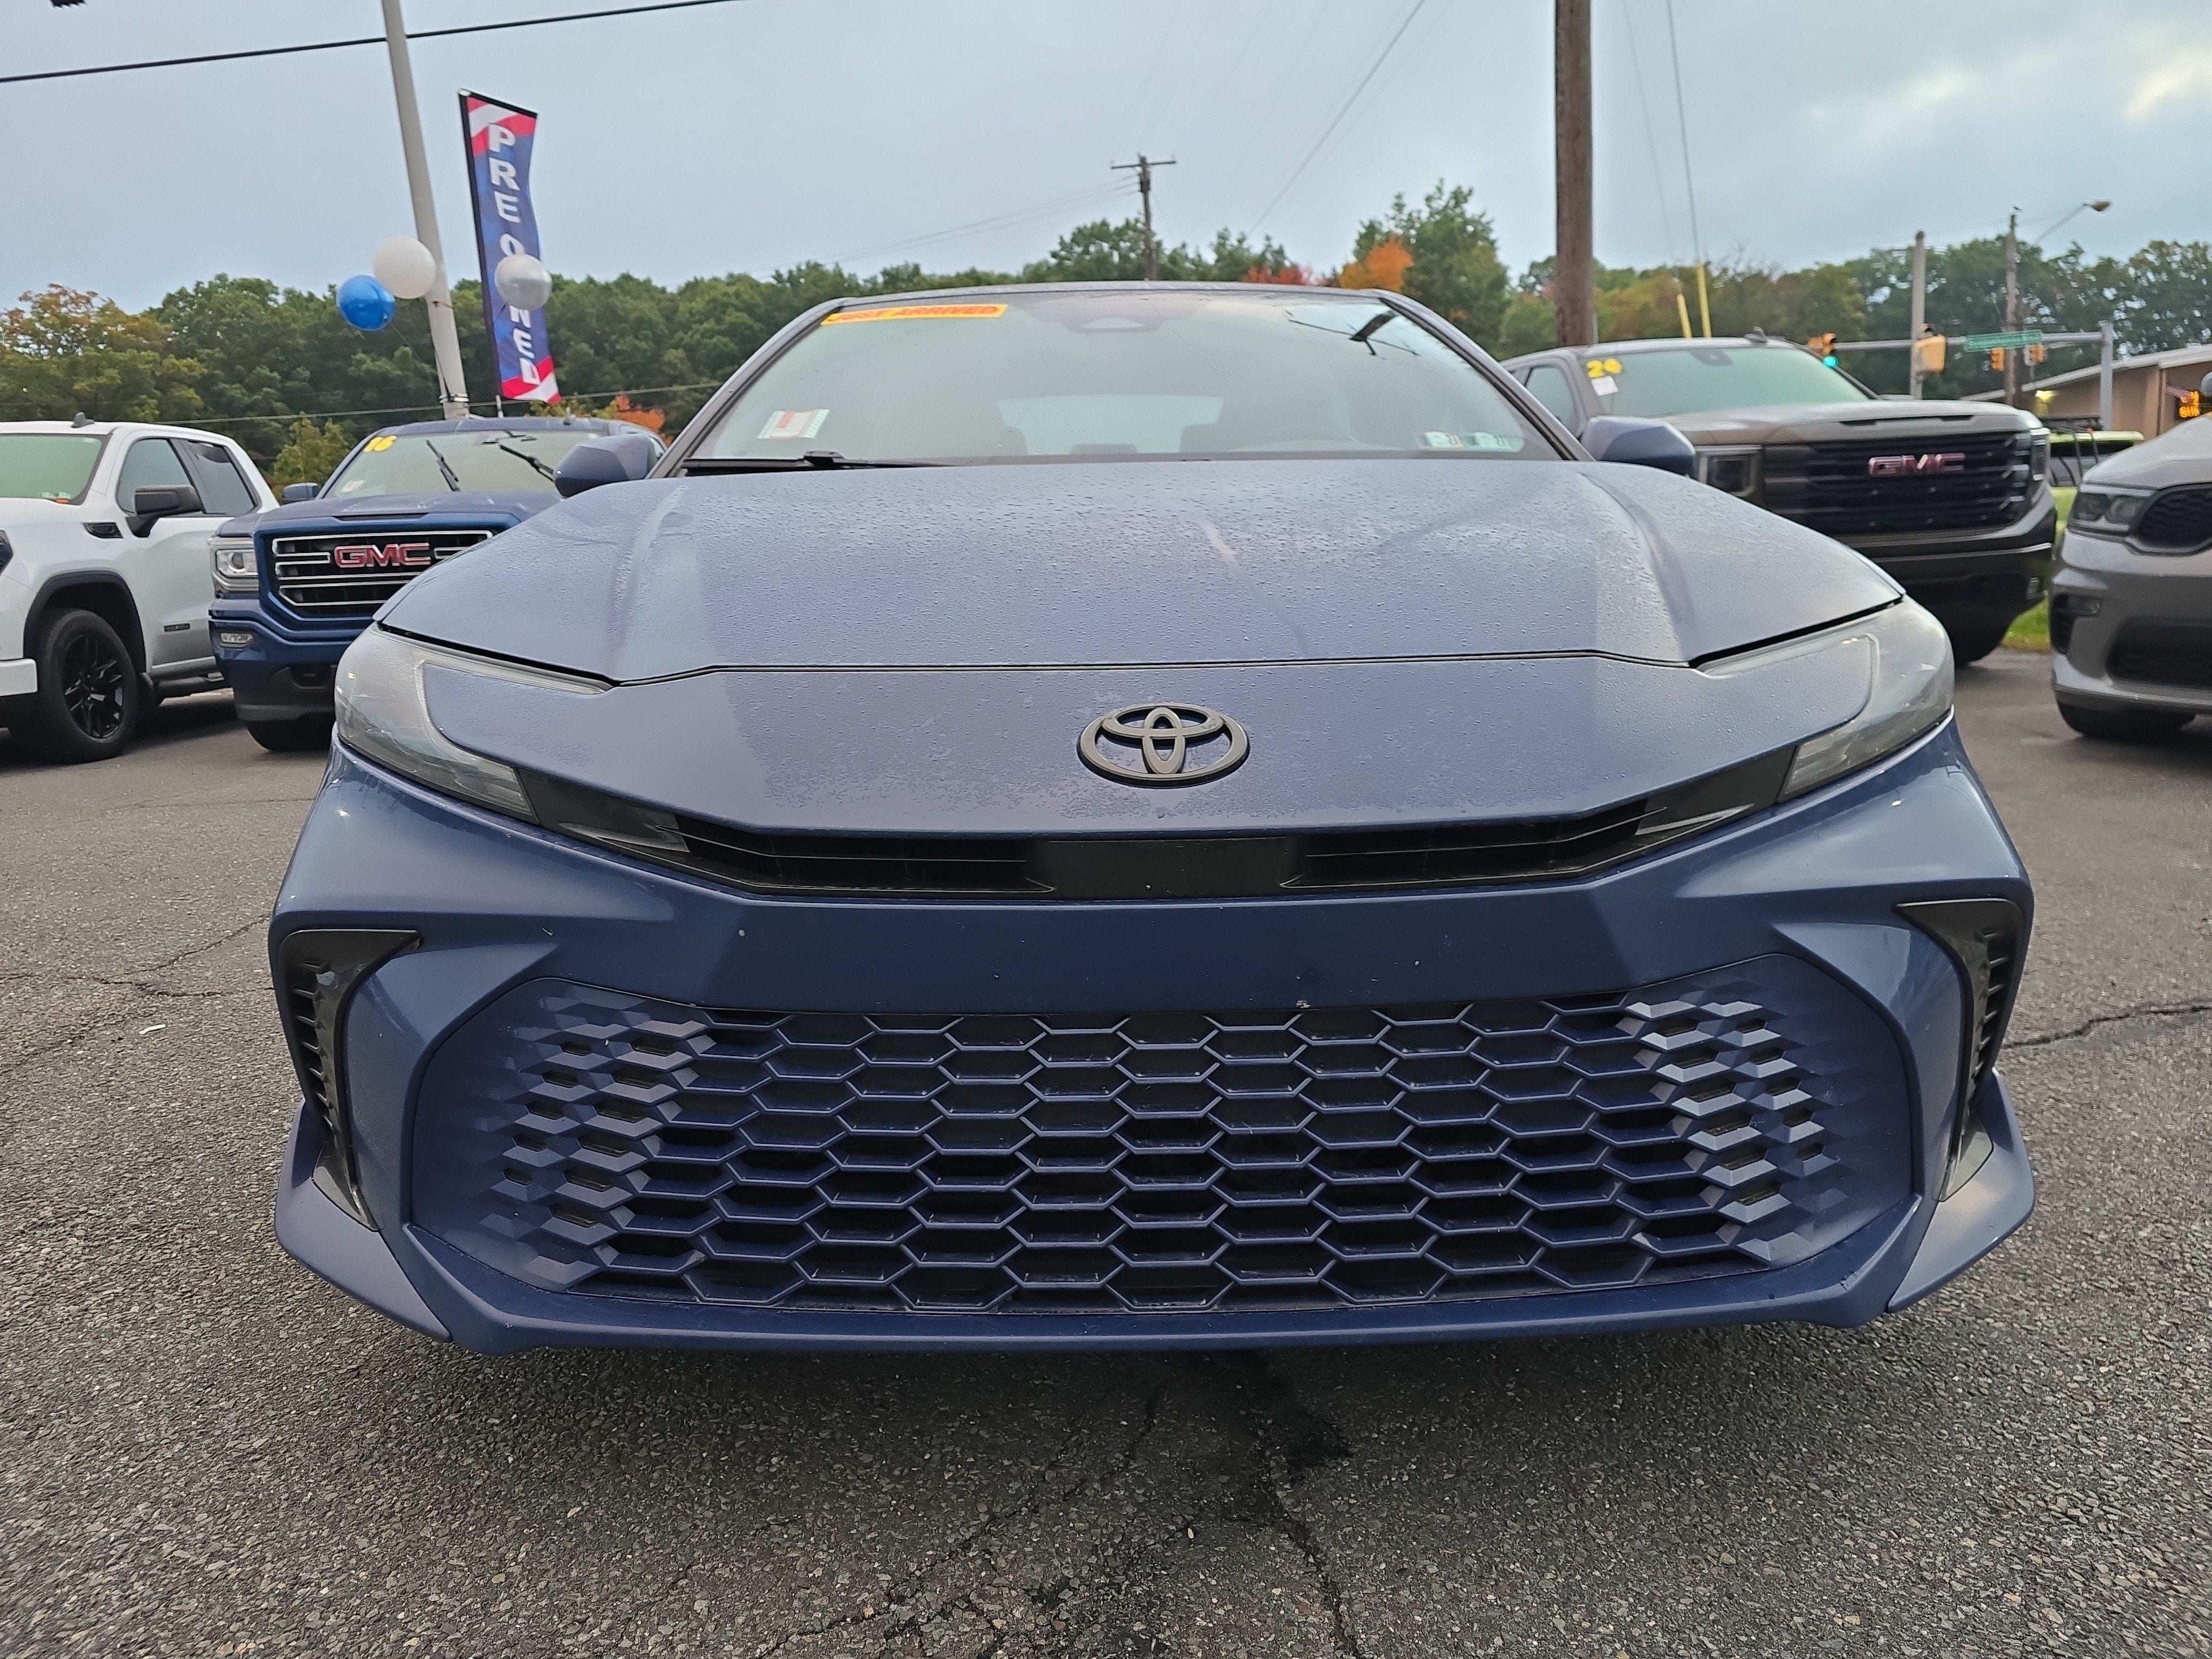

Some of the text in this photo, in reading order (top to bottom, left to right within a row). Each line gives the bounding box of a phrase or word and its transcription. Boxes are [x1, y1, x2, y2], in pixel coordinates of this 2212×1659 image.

[488, 123, 542, 386] PRE ONED
[1868, 452, 1966, 477] GMC
[334, 542, 432, 568] GMC
